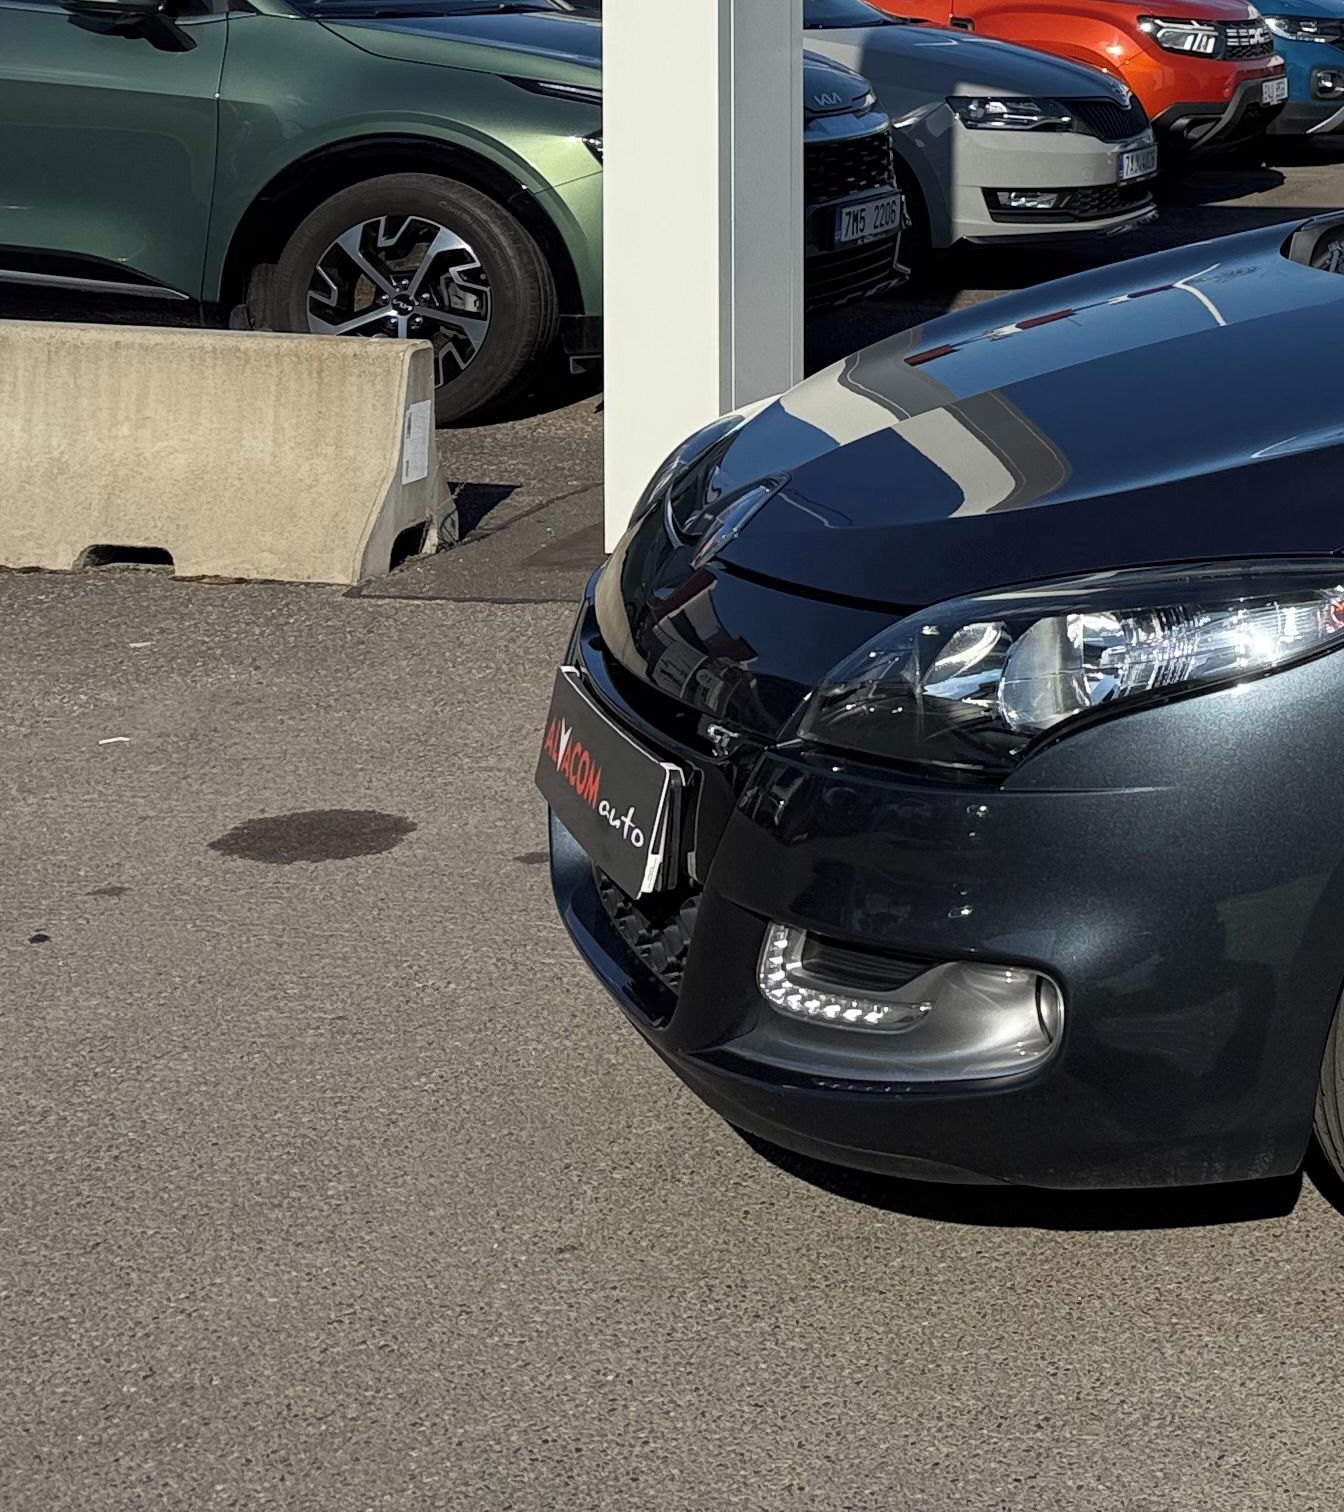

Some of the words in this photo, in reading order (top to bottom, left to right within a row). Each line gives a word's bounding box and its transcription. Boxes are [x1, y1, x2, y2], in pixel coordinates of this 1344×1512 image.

[844, 208, 867, 238] 7M5
[873, 199, 897, 230] 2206
[544, 717, 602, 809] ALVACOM
[598, 799, 644, 848] auto
